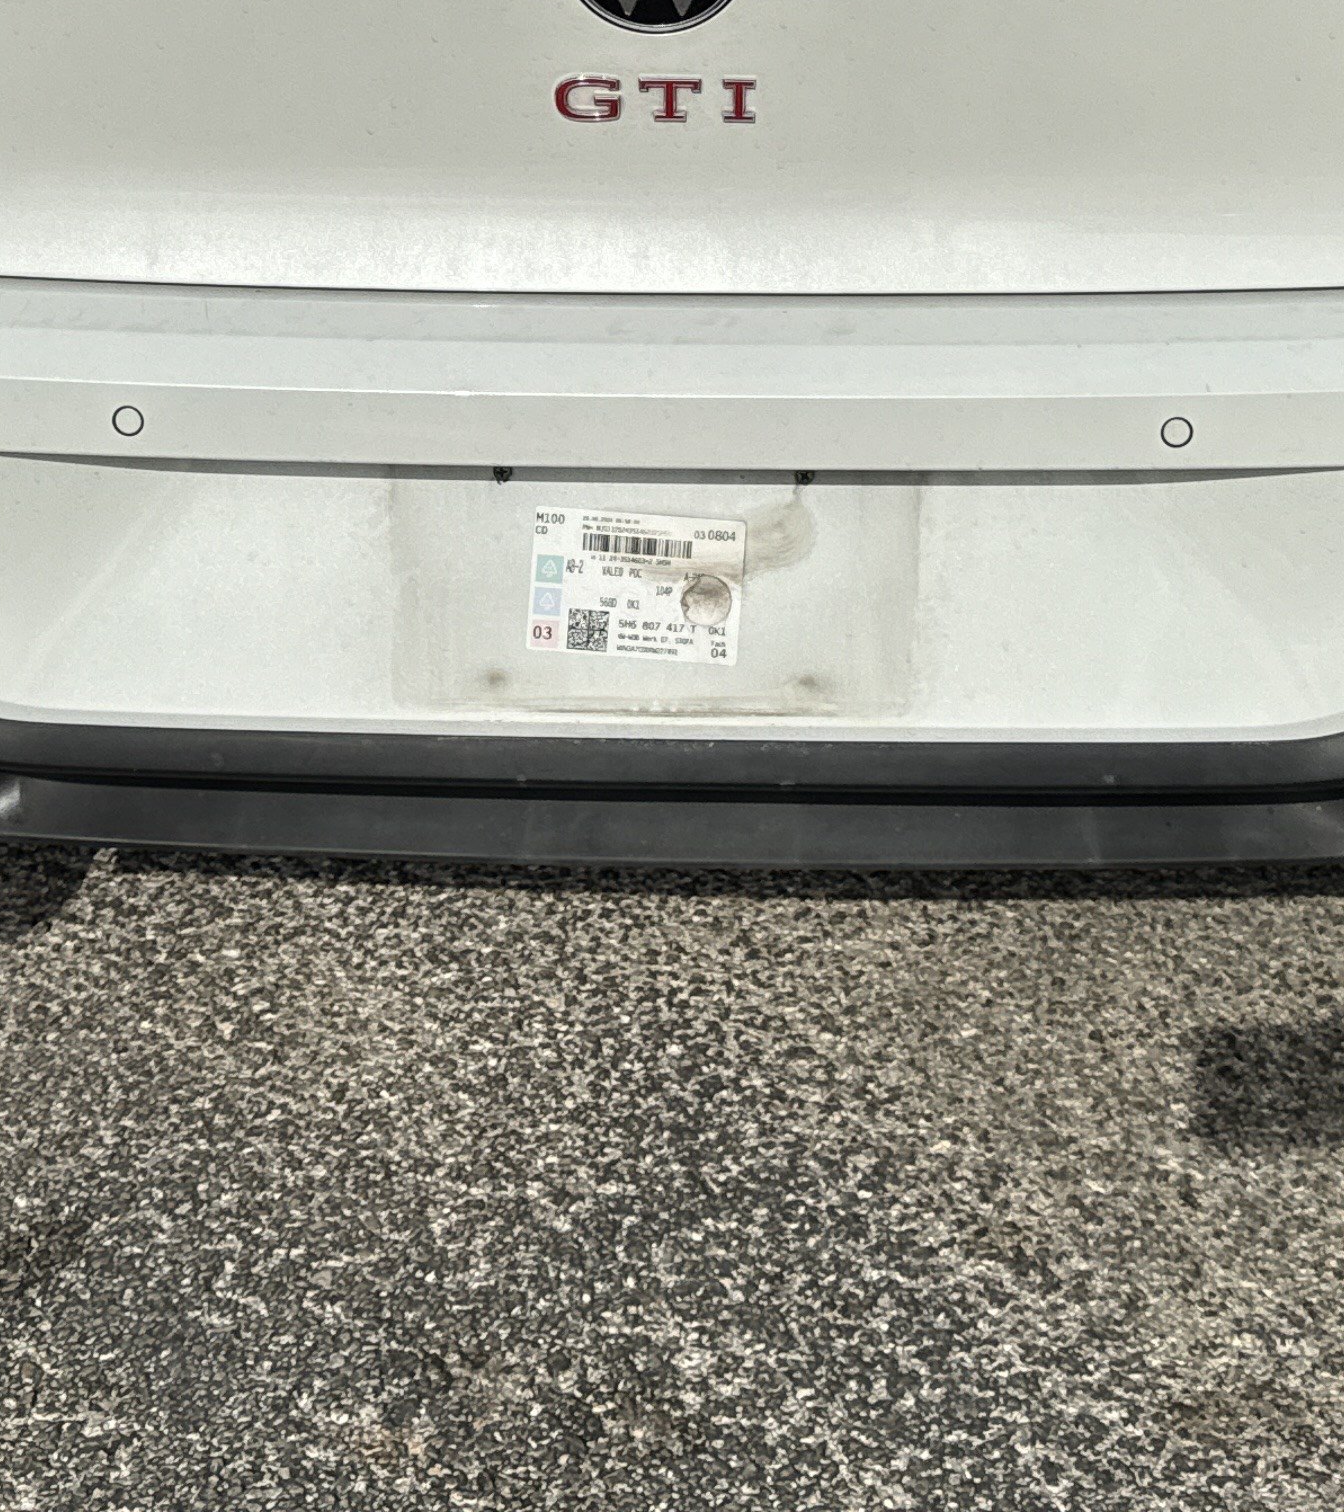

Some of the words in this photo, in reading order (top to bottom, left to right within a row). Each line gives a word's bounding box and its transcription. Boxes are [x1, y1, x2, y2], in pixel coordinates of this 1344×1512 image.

[554, 72, 757, 124] GTI
[536, 512, 566, 525] M100
[535, 525, 549, 536] CD
[693, 530, 706, 540] 03
[707, 529, 737, 542] 0804
[532, 625, 554, 641] 03
[642, 621, 662, 632] 807
[666, 622, 685, 634] 417
[710, 648, 728, 660] 04
